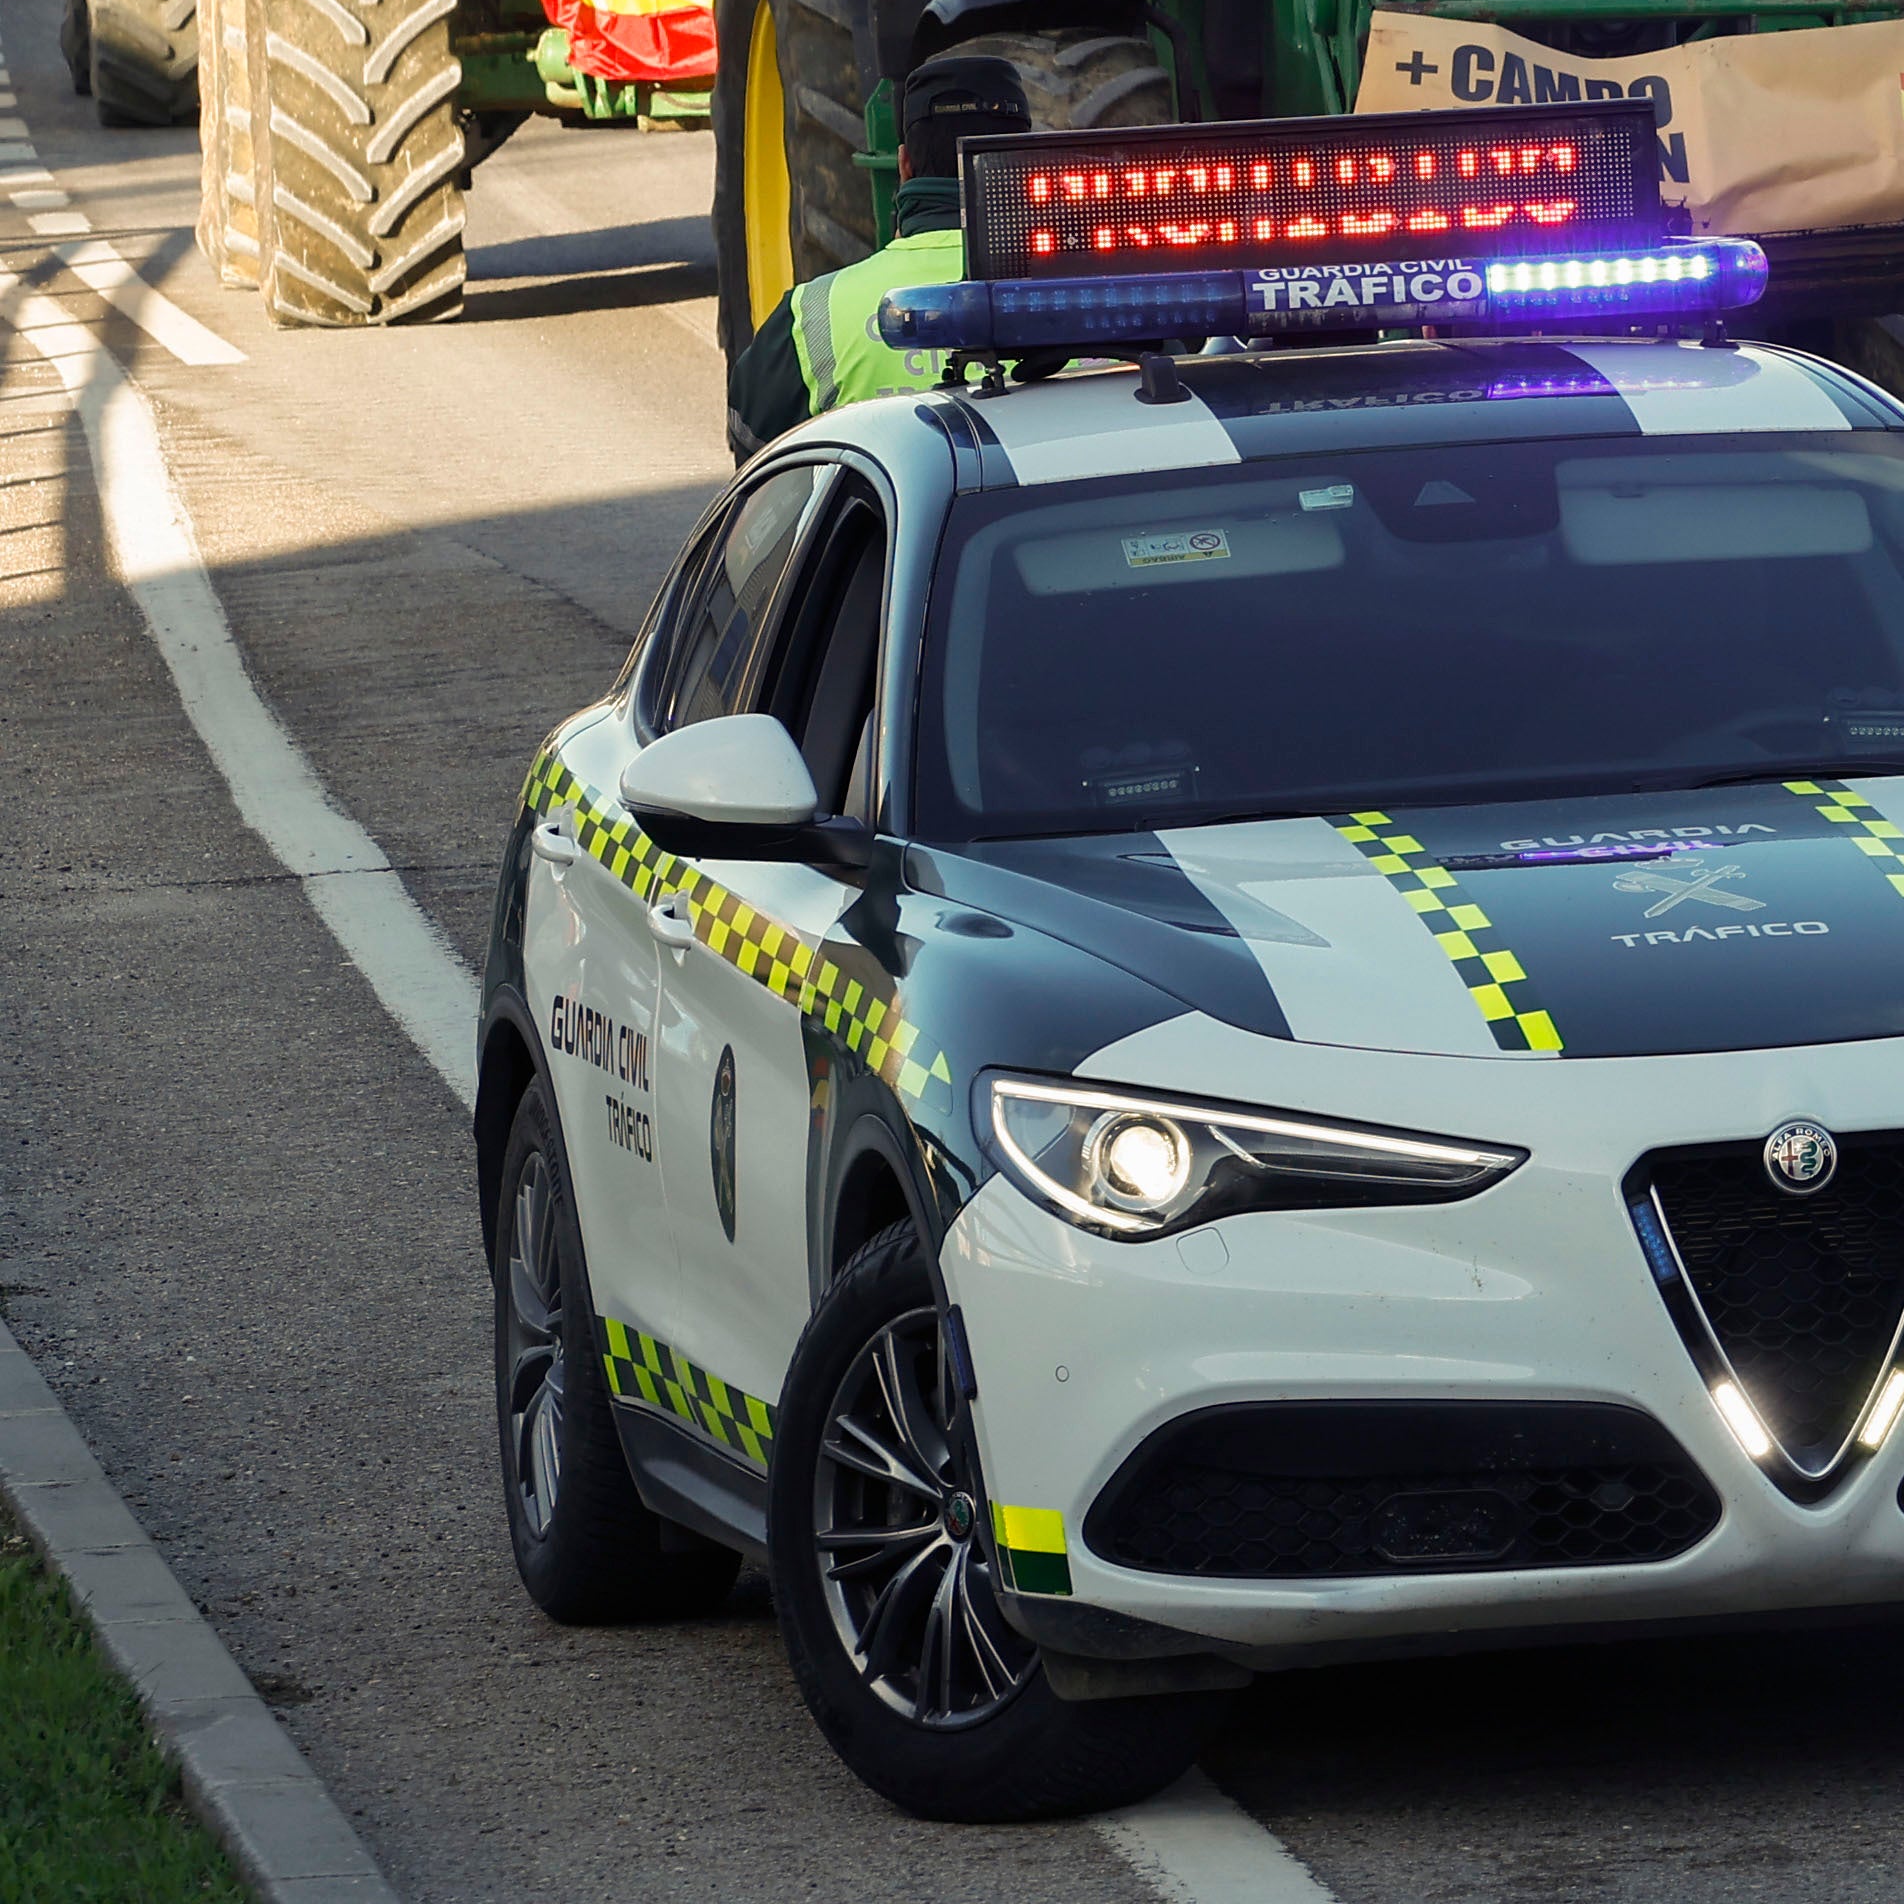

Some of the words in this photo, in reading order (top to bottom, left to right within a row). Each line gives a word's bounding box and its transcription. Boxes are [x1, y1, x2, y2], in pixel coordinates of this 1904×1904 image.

[1258, 262, 1394, 281] GUARDIA
[1399, 257, 1473, 274] CIVIL
[1252, 270, 1483, 311] TRÁFICO
[1500, 823, 1778, 852] GUARDIA
[1610, 921, 1831, 948] TRÁFICO
[551, 994, 615, 1076] GUARDIA
[618, 1024, 649, 1093] CIVIL
[605, 1090, 653, 1164] TRÁFICO
[1771, 1131, 1792, 1162] ALFA
[1795, 1127, 1832, 1157] ROMEO
